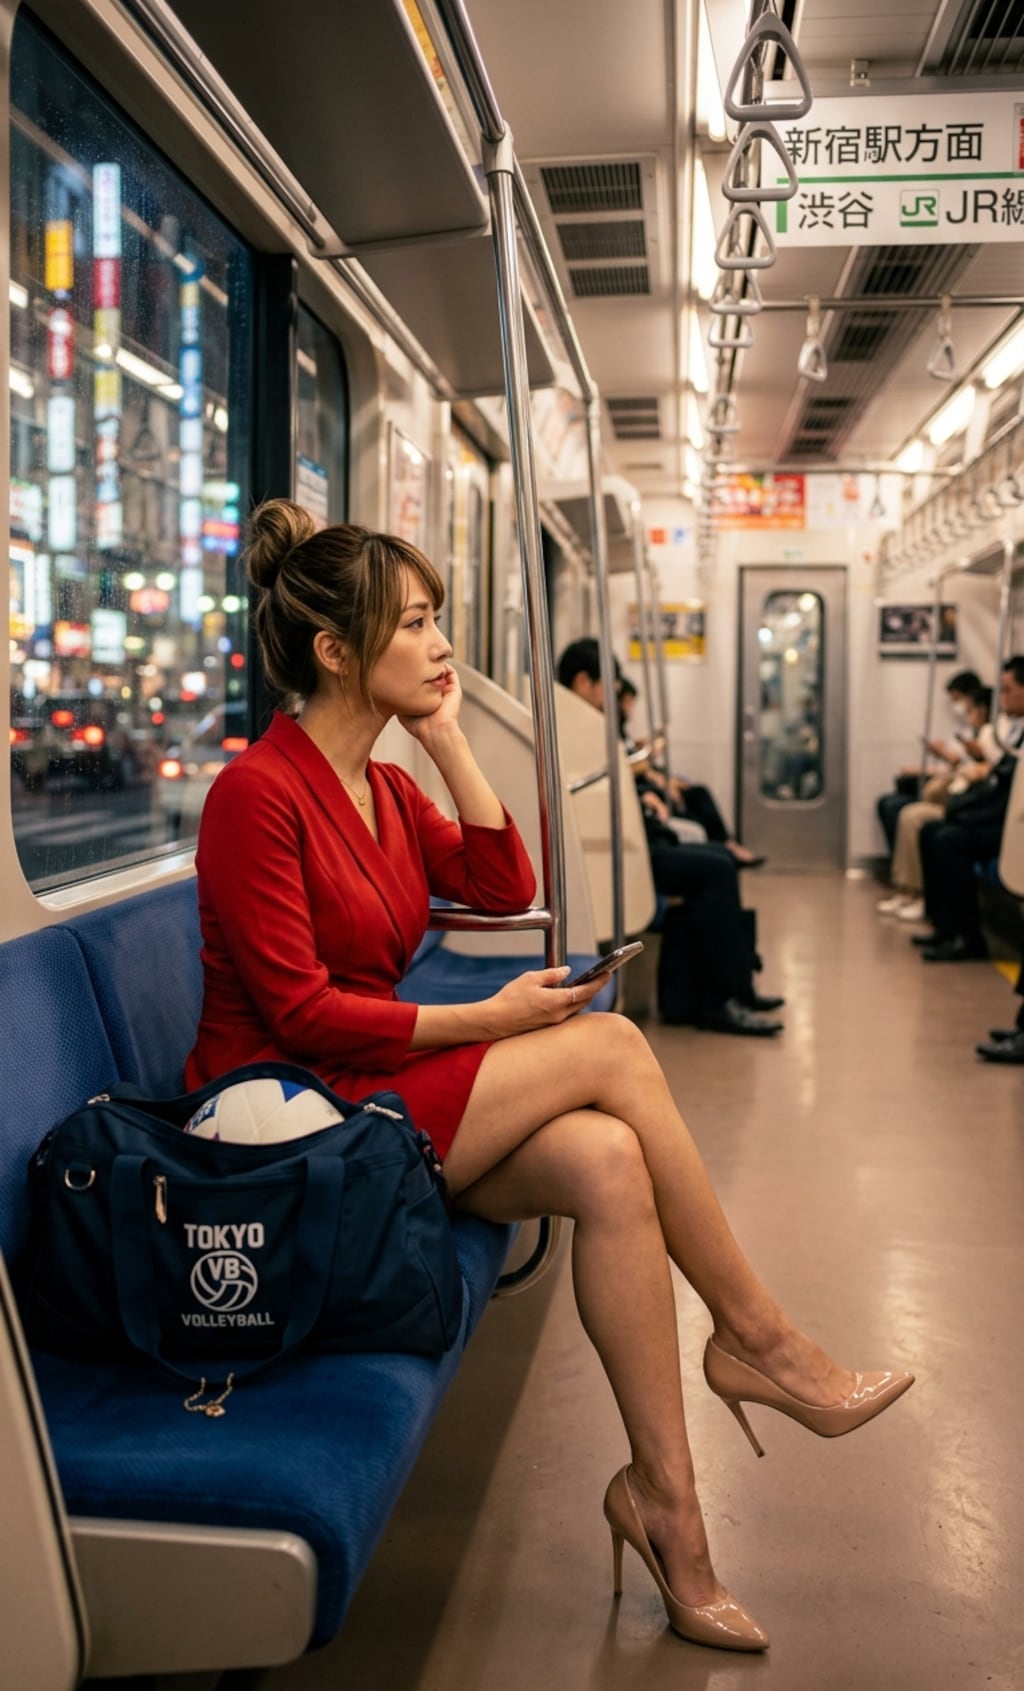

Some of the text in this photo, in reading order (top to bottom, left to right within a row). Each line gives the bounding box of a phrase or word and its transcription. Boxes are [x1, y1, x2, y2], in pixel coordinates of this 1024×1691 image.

[784, 123, 984, 166] 新宿駅方面
[798, 191, 873, 229] 渋谷
[902, 196, 937, 216] JR
[184, 1222, 264, 1249] TOKYO
[207, 1258, 240, 1280] VB
[181, 1312, 274, 1327] VOLLEYBALL
